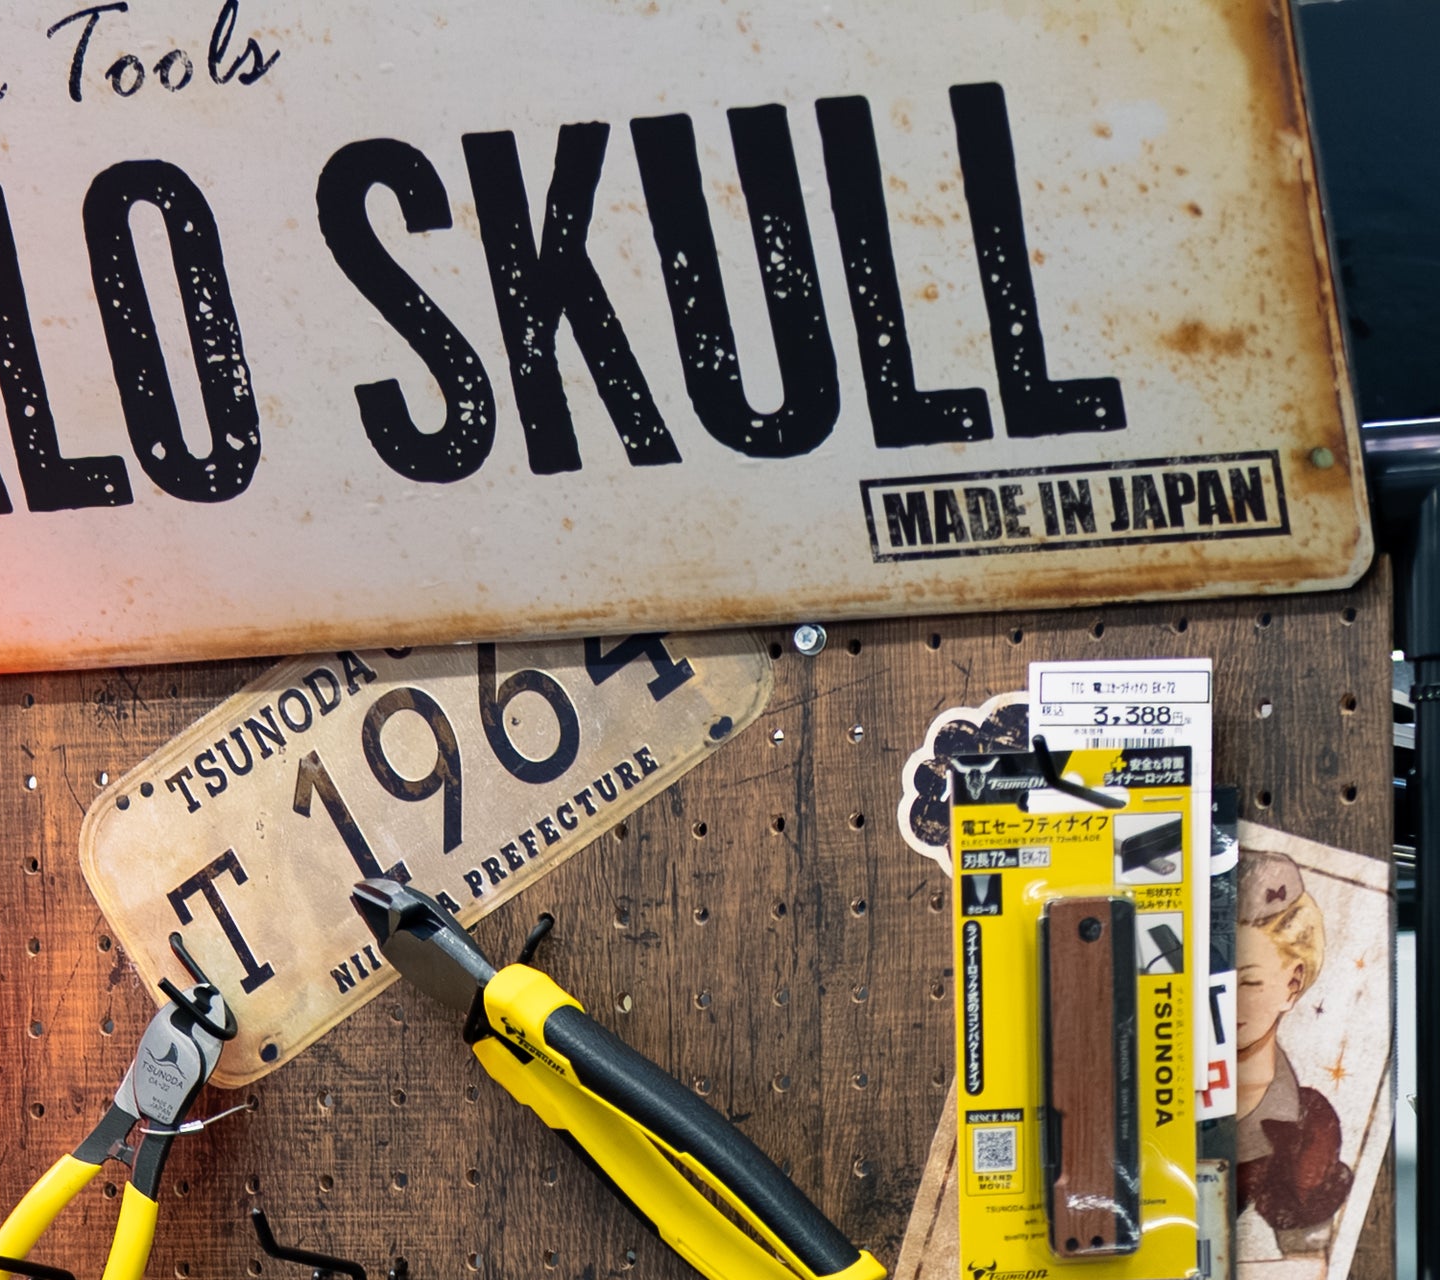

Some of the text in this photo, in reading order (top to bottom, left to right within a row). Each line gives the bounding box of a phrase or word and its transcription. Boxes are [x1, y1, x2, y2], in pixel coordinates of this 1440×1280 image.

[47, 0, 281, 101] Tools
[316, 82, 1127, 485] SKULL
[881, 466, 1271, 551] MADE IN JAPAN
[1042, 705, 1064, 716] 税込
[1152, 682, 1176, 693] EK-72
[163, 653, 380, 814] TSUNODA
[463, 744, 660, 897] PREFECTURE
[1104, 772, 1185, 786] ライナーロック式
[961, 815, 1109, 837] 電工セーフティナイフ
[1021, 848, 1048, 866] EK-72
[166, 848, 275, 995] T
[141, 1059, 185, 1090] TSUNODA
[1154, 982, 1173, 1129] TSUNODA
